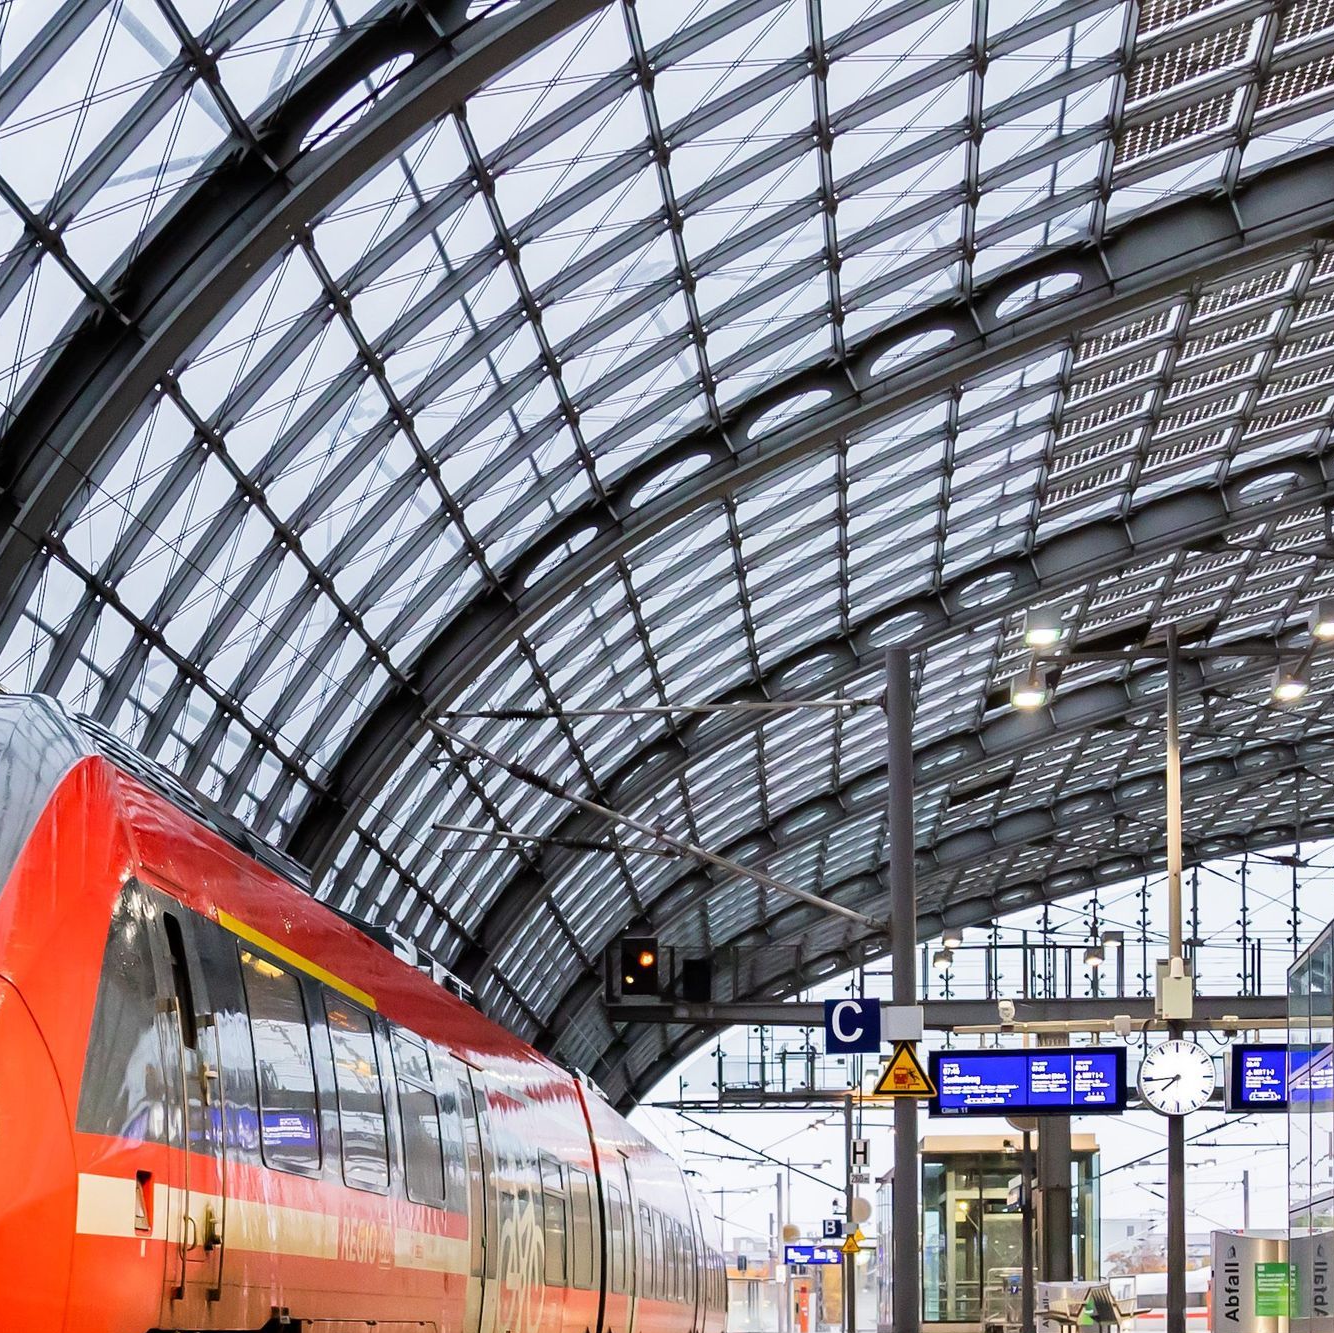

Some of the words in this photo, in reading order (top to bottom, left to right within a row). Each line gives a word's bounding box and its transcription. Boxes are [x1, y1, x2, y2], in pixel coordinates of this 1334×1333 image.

[832, 1000, 864, 1043] C
[852, 1141, 868, 1165] H
[825, 1220, 836, 1235] B
[1224, 1262, 1240, 1322] Abfall
